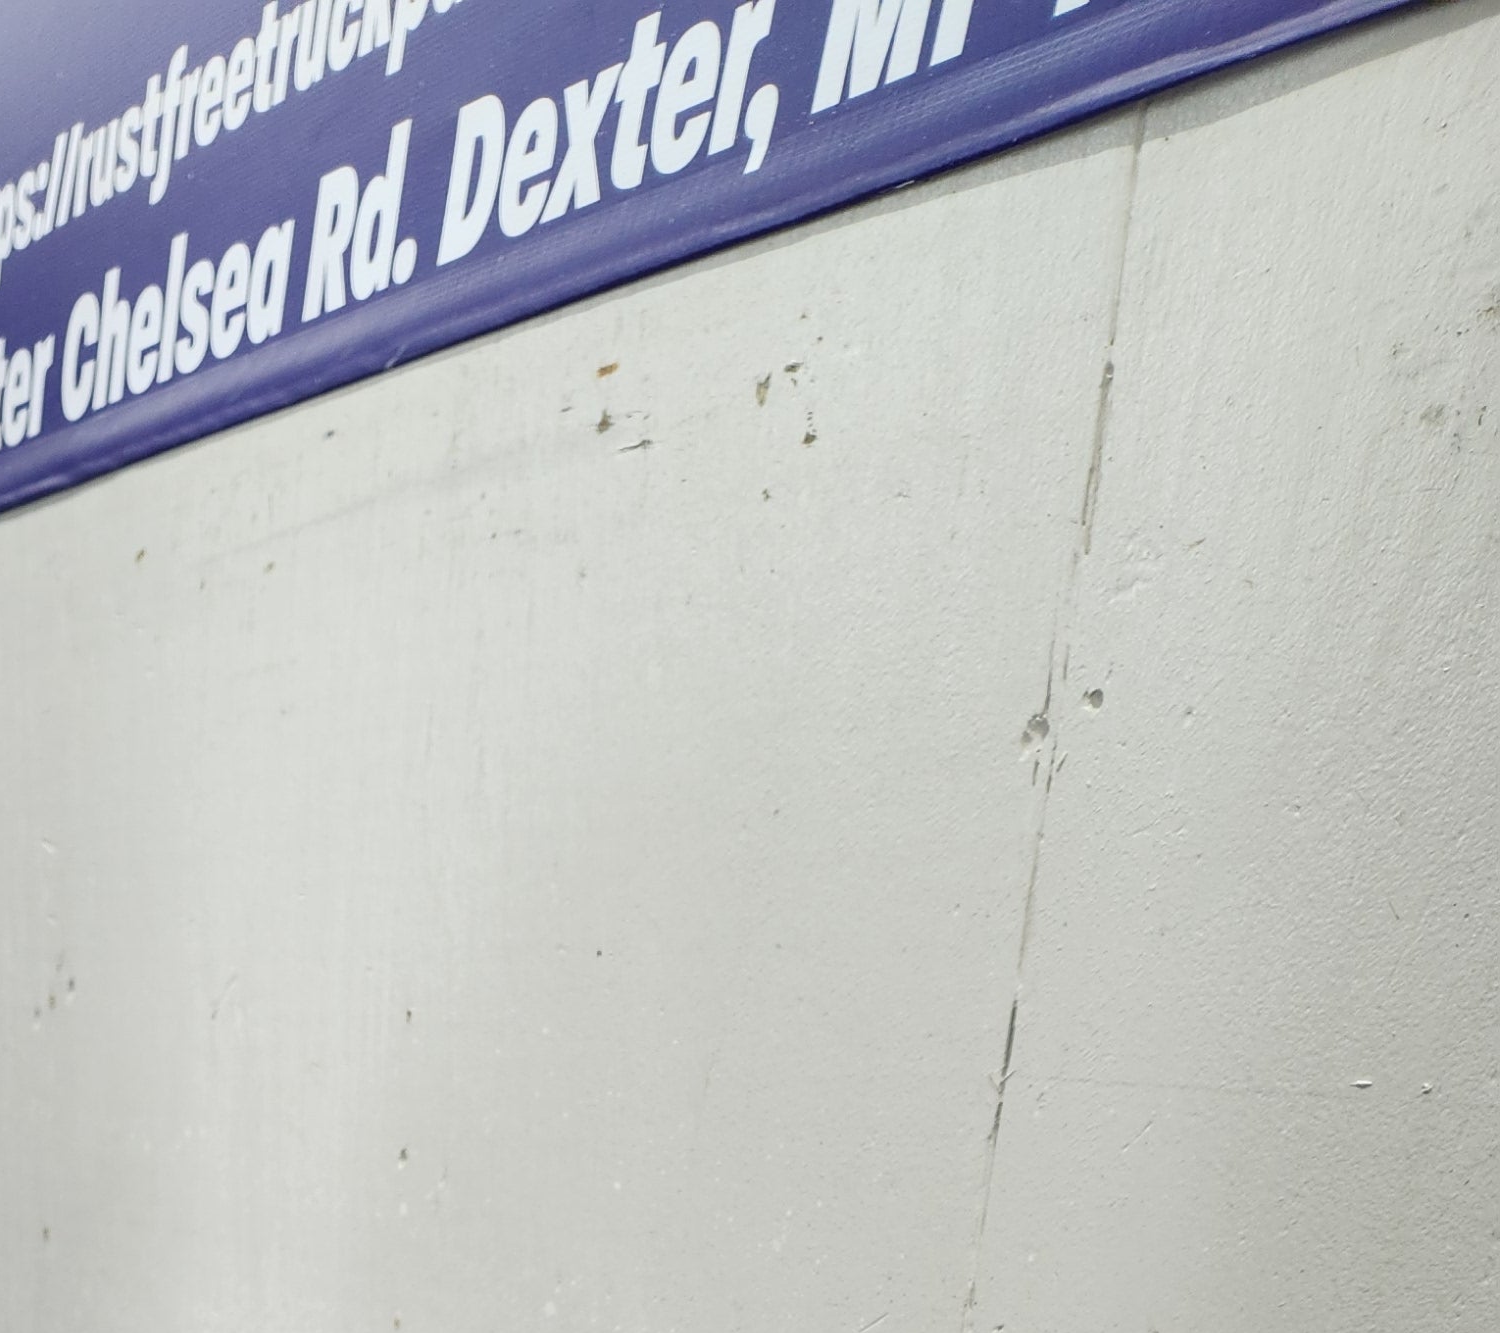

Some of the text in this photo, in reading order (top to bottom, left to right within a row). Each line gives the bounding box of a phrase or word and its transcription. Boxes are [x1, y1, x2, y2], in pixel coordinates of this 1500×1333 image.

[60, 219, 296, 422] Chelsea
[302, 118, 418, 322] Rd.
[436, 0, 779, 267] Dexter,
